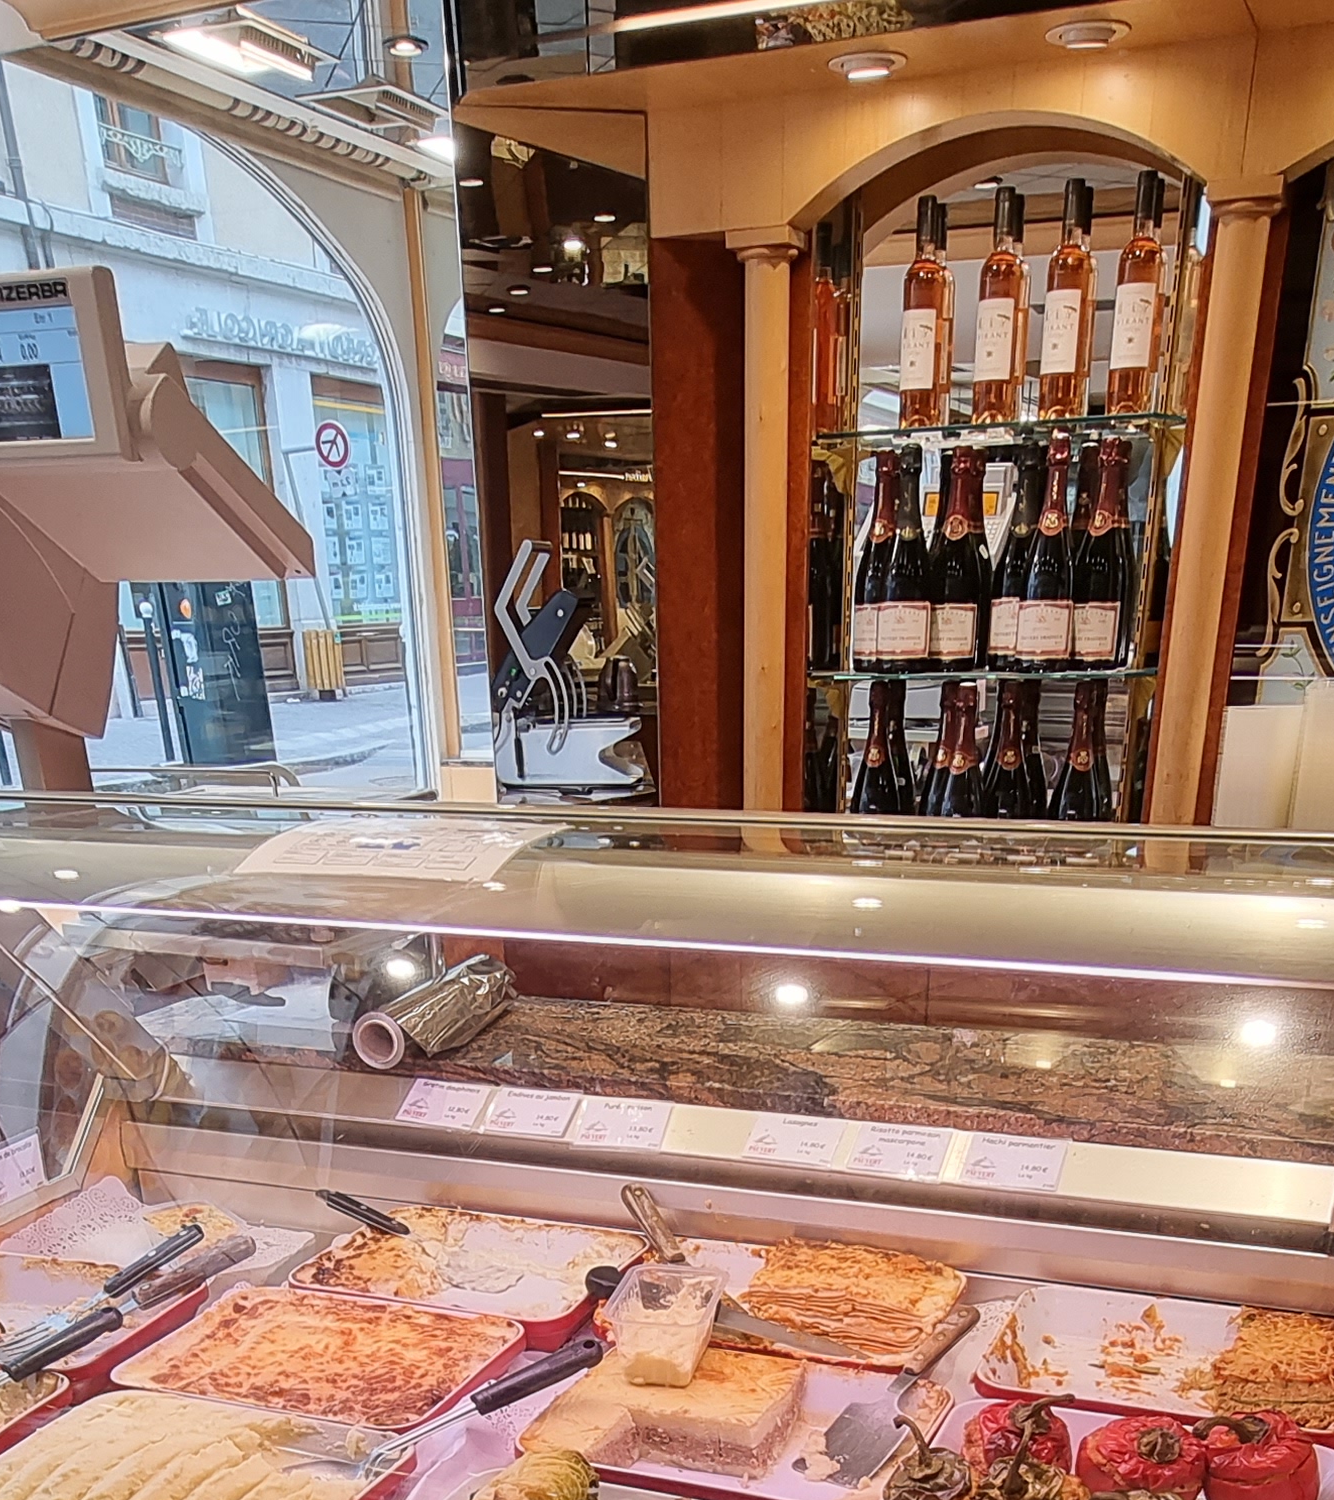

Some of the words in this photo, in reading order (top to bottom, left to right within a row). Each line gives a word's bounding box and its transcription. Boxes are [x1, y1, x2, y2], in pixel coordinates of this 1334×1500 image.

[507, 1090, 534, 1099] Endives
[544, 1094, 571, 1102] jambon
[782, 1117, 818, 1127] Lasagnes
[870, 1125, 900, 1135] Risotto
[901, 1129, 941, 1138] parmesan
[878, 1137, 926, 1147] mascarpone
[1007, 1140, 1056, 1150] parmentier
